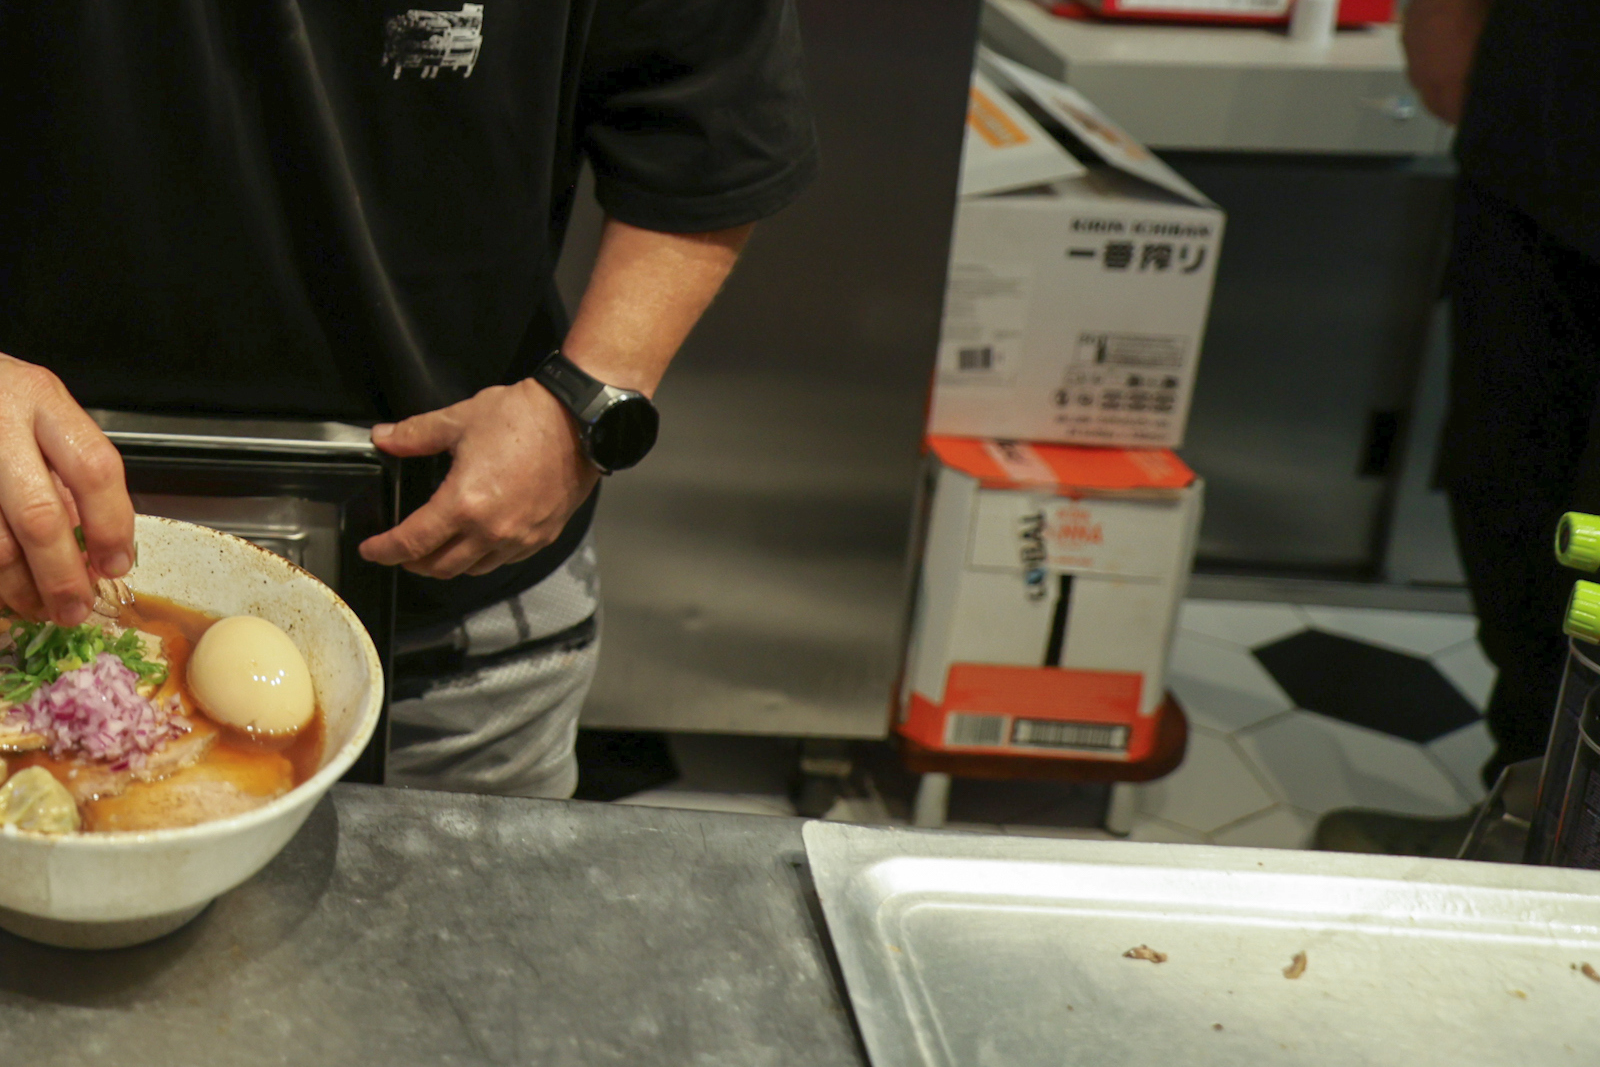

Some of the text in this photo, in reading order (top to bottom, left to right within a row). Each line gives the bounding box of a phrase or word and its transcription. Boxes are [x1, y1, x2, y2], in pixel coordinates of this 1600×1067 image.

[1071, 218, 1124, 233] KIRIN
[1068, 240, 1206, 273] 一番搾り
